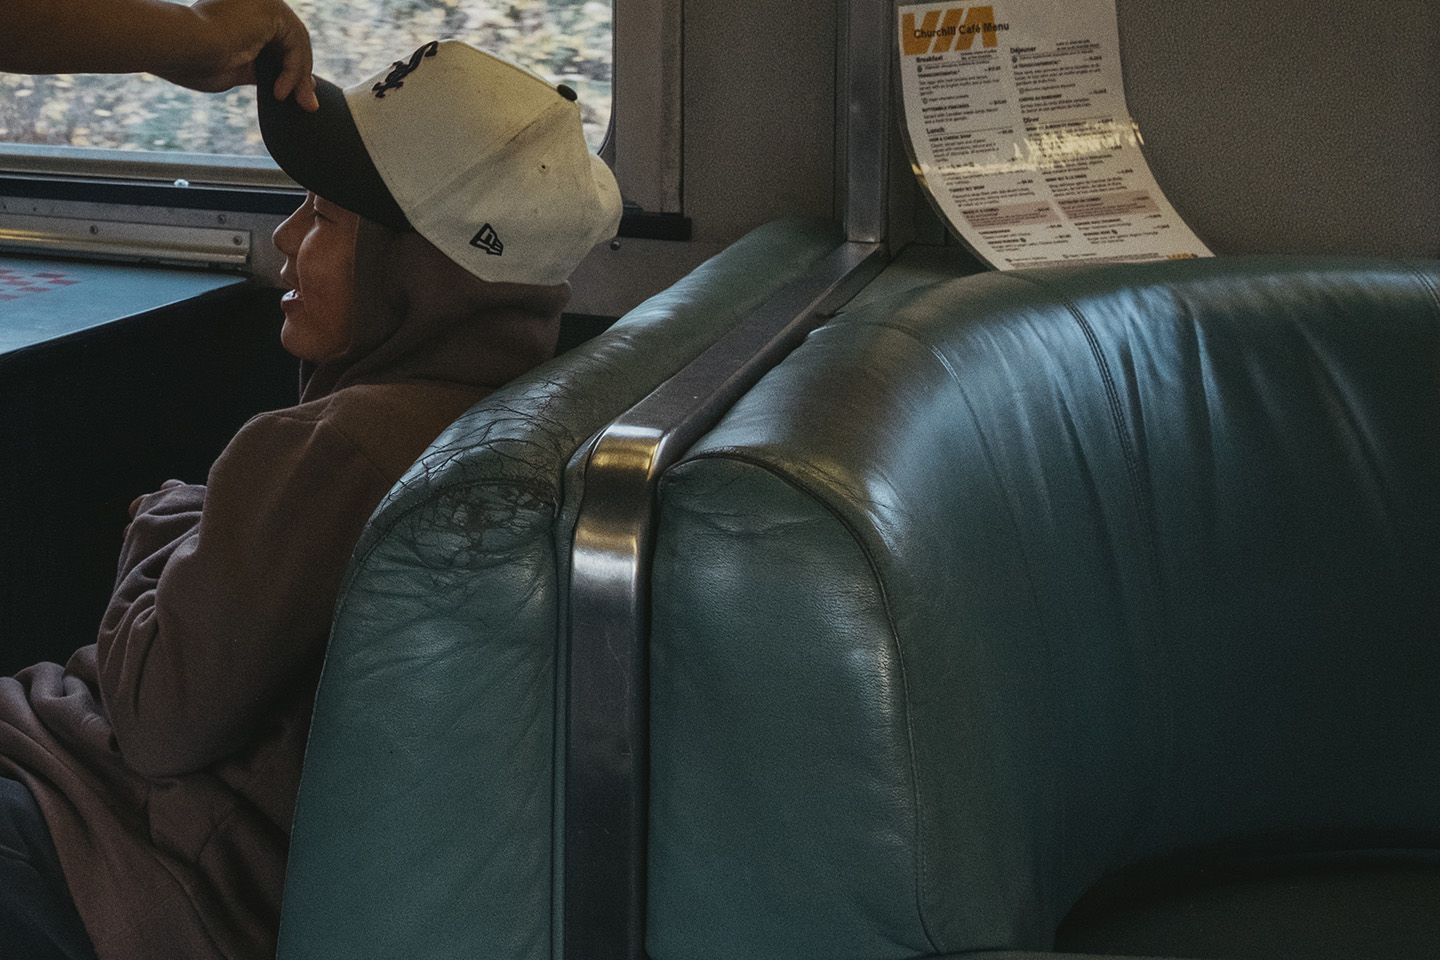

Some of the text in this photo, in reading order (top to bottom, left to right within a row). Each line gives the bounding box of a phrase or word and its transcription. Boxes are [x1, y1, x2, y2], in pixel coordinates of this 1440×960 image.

[902, 6, 998, 56] VIA
[914, 22, 1009, 39] Churchill Café Menu
